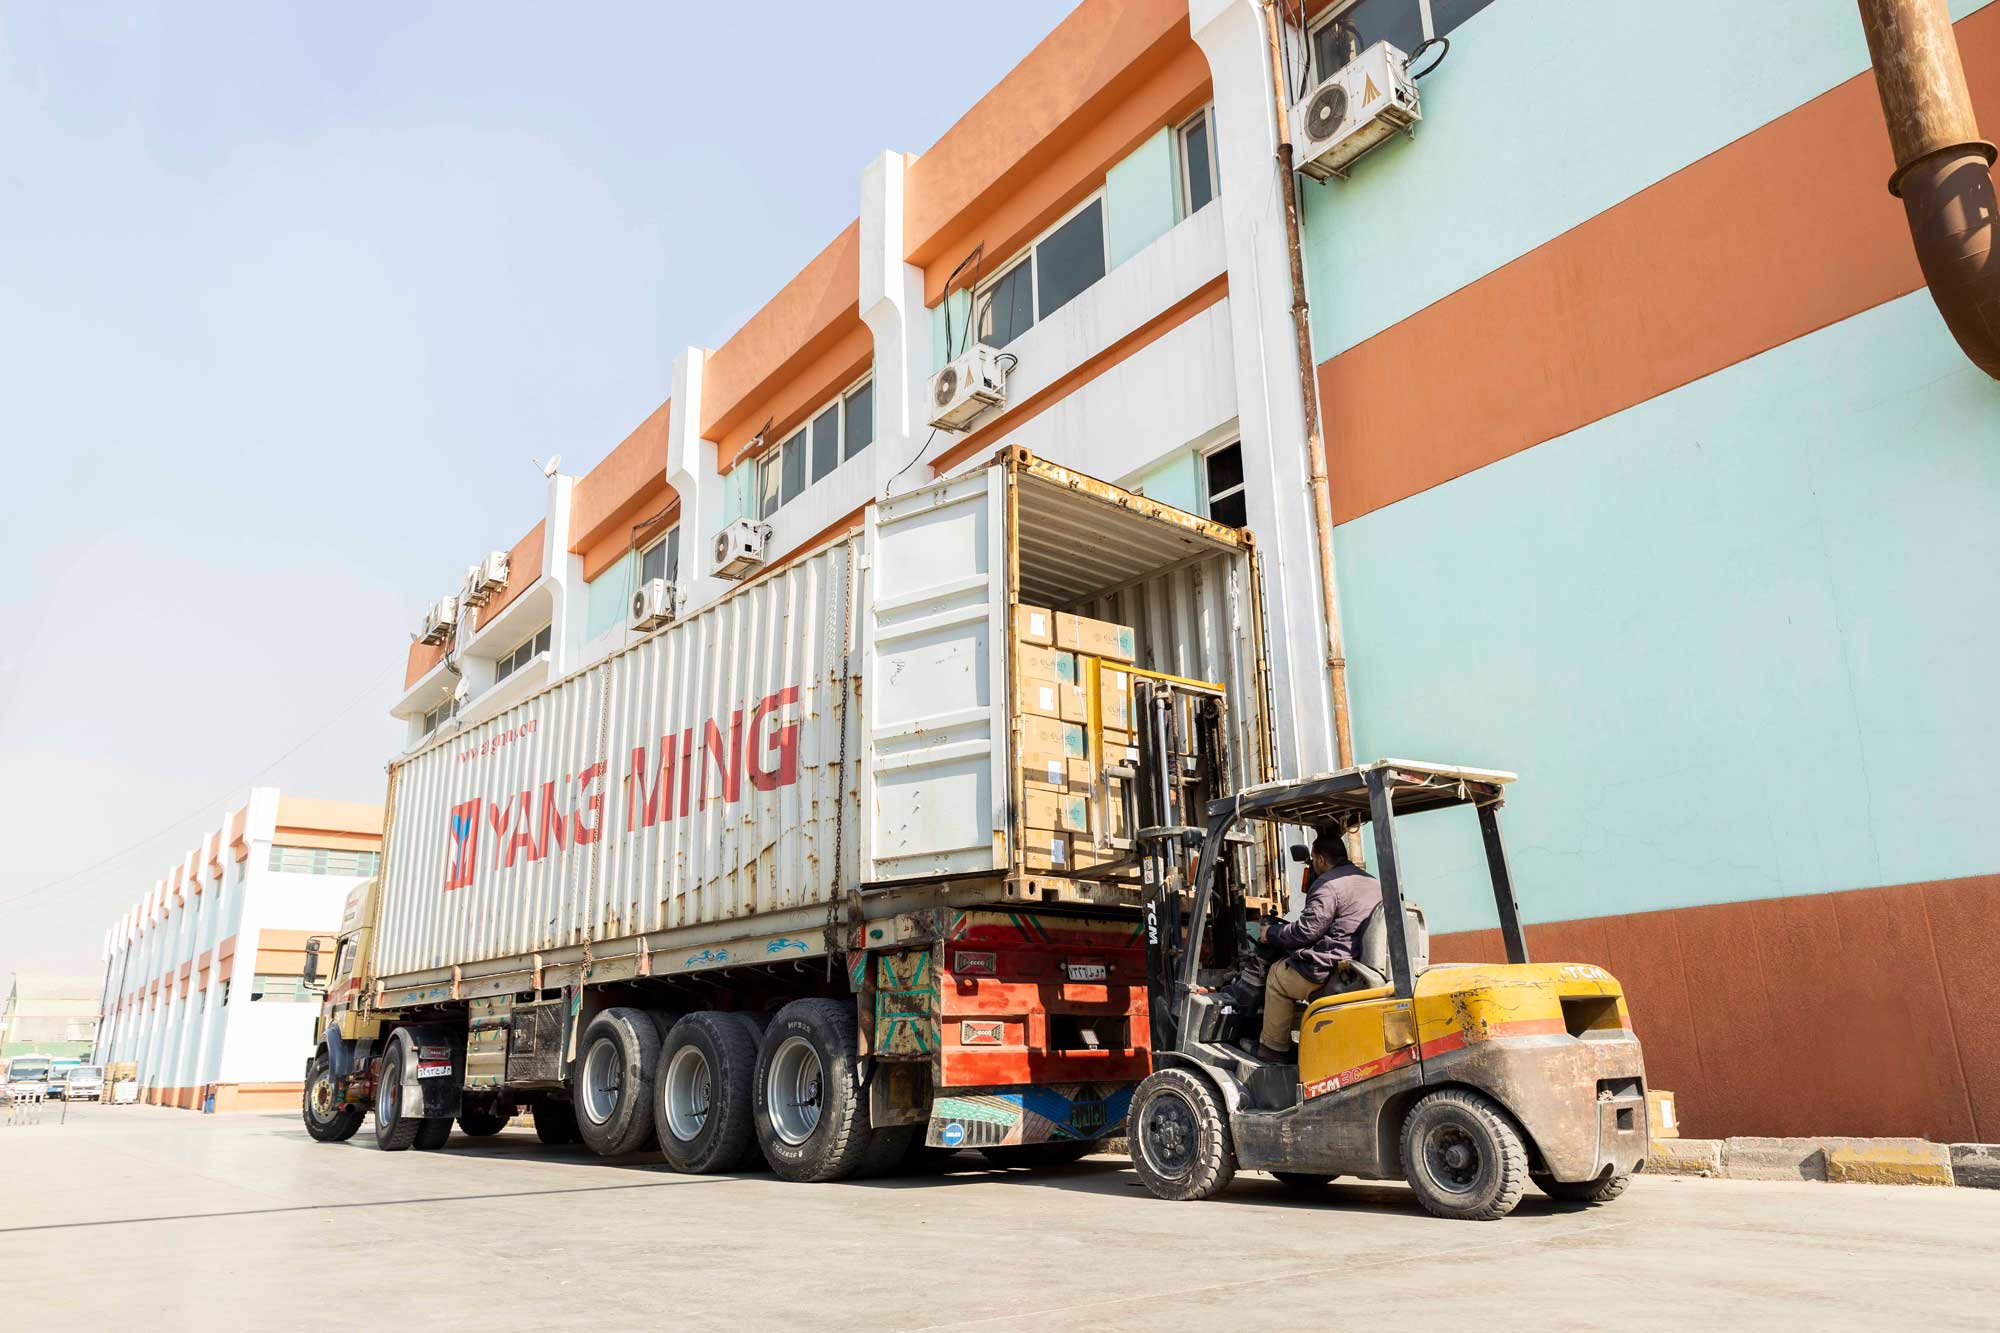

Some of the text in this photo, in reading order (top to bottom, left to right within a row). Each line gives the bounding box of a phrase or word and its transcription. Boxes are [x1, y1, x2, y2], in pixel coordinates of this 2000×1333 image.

[490, 760, 608, 870] YANG
[628, 685, 799, 832] MING
[1147, 900, 1158, 945] TCM
[1563, 966, 1609, 980] TCM
[1309, 1077, 1340, 1097] TCM
